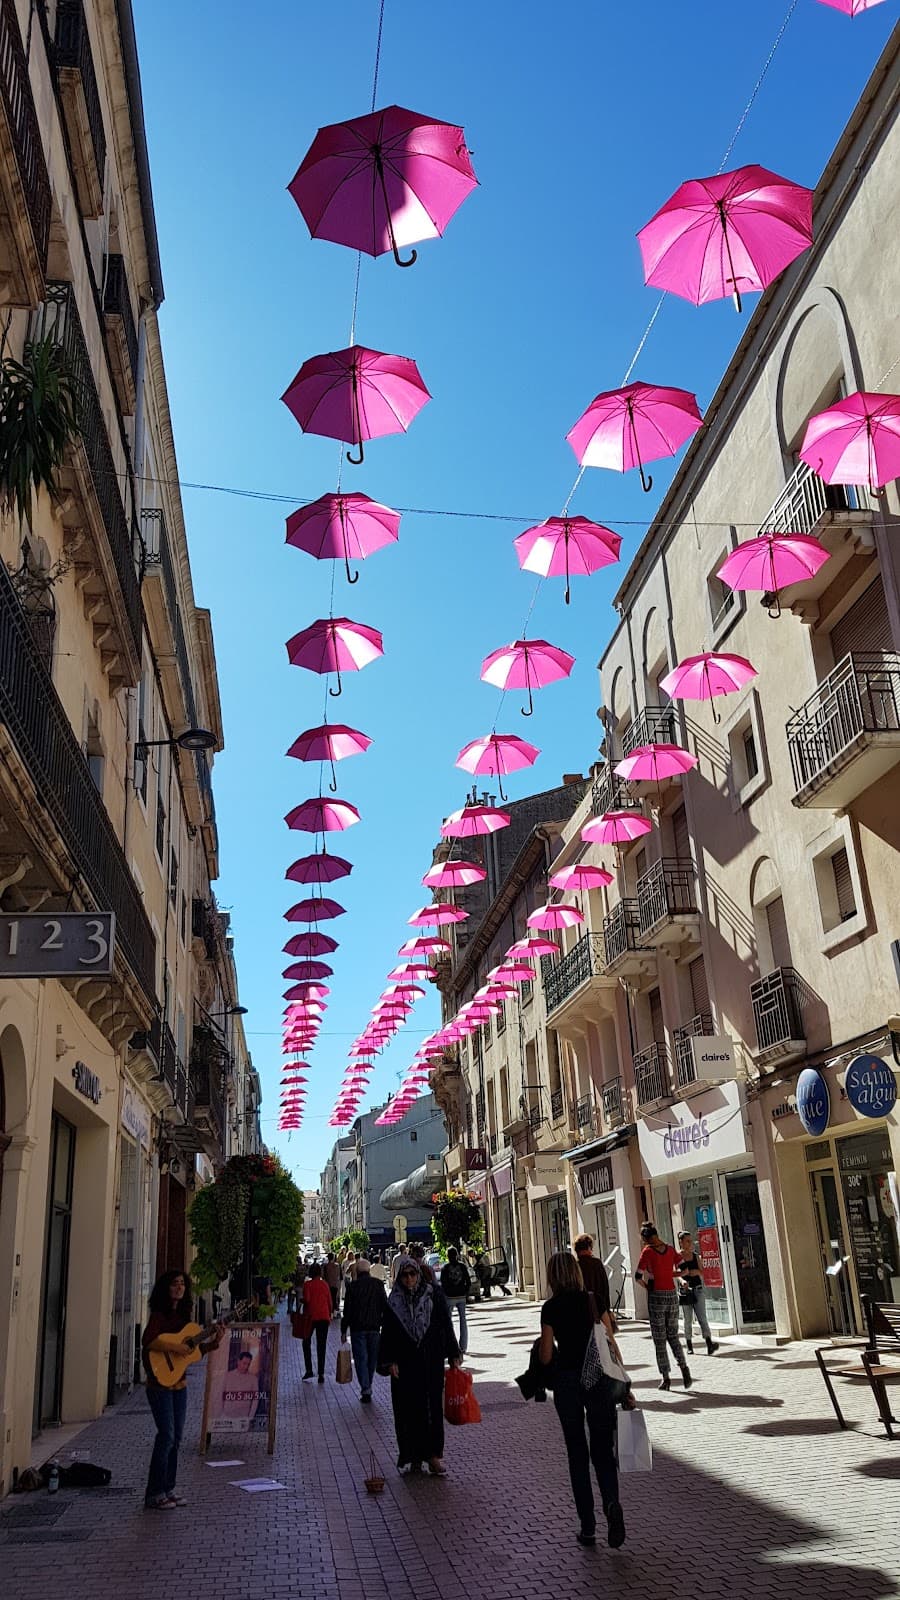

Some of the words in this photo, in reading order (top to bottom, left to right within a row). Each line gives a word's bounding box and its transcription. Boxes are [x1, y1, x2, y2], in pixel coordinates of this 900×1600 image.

[701, 1053, 730, 1062] claire's
[858, 1082, 896, 1110] algu
[663, 1112, 710, 1159] claire's
